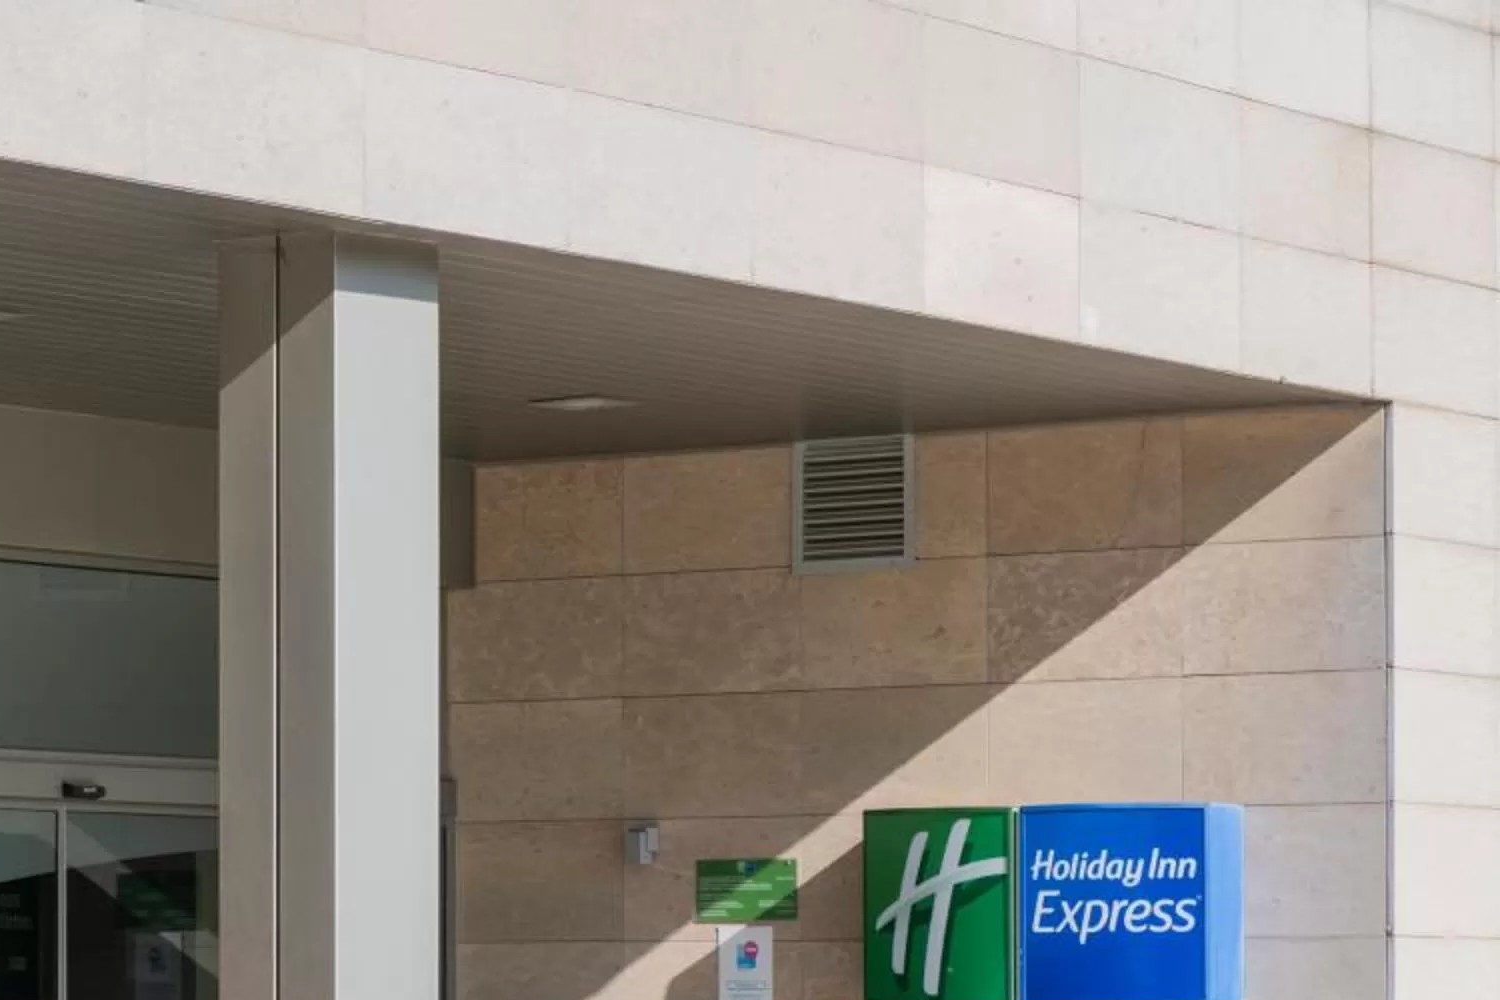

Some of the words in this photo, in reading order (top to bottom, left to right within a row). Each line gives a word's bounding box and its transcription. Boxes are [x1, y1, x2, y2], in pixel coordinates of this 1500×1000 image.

[1030, 849, 1145, 887] Holiday
[1148, 847, 1198, 880] Inn
[1031, 889, 1198, 945] Express
